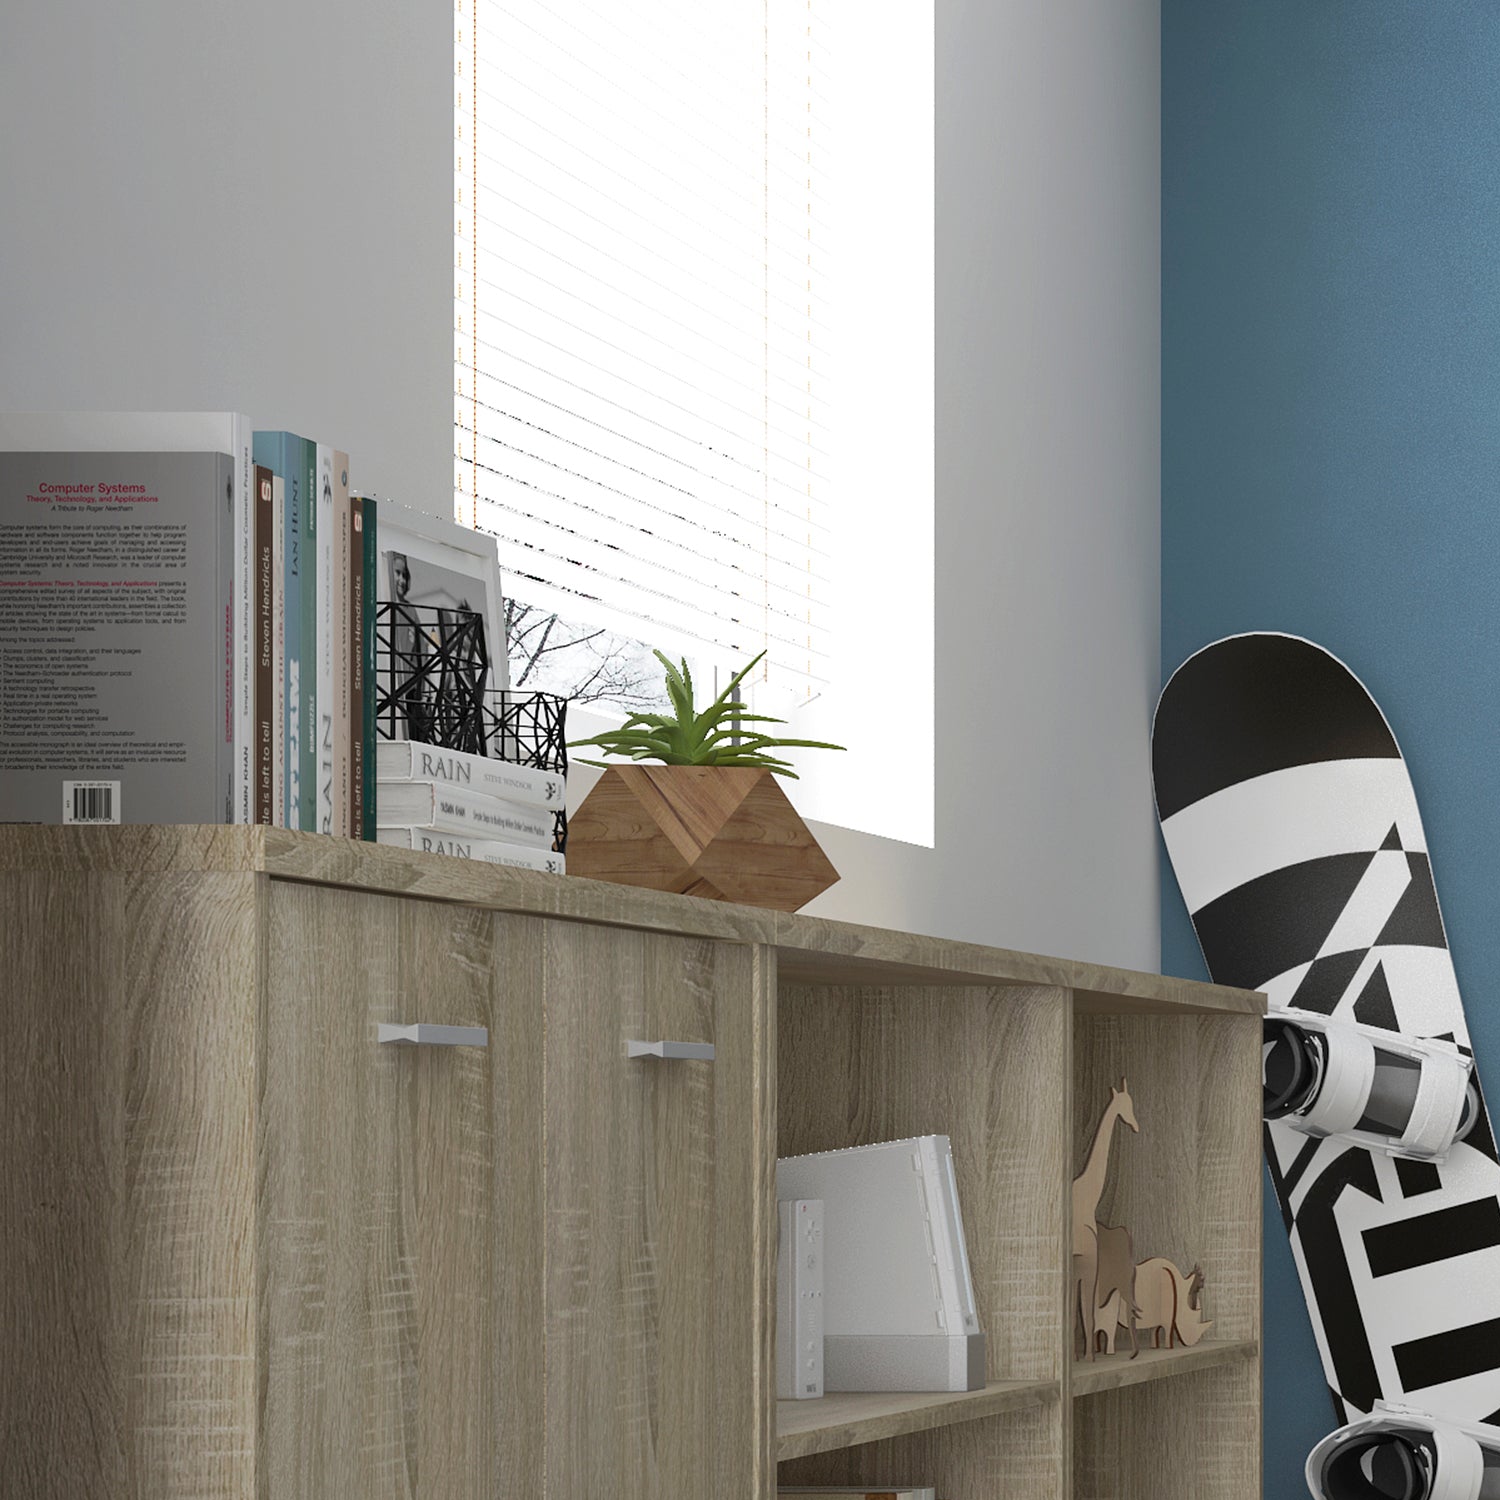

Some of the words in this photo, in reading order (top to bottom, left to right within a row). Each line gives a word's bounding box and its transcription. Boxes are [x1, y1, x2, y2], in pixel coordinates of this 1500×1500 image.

[38, 482, 95, 495] Computer
[98, 482, 146, 495] Systems
[26, 495, 52, 504] Theory,
[54, 495, 96, 504] Technology,
[99, 495, 112, 504] and
[114, 495, 159, 504] Applications
[261, 547, 270, 616] Hendricks
[261, 621, 270, 667] Steven
[261, 721, 270, 742] tell
[261, 747, 270, 762] to
[290, 659, 299, 831] STEAM
[261, 764, 270, 788] left
[322, 714, 332, 836] RAIN
[354, 766, 361, 780] to
[421, 752, 471, 784] RAIN
[484, 773, 502, 785] STEVE
[503, 776, 533, 790] WINDSOR
[261, 792, 270, 803] is
[354, 807, 361, 819] is
[421, 837, 471, 859] RAIN
